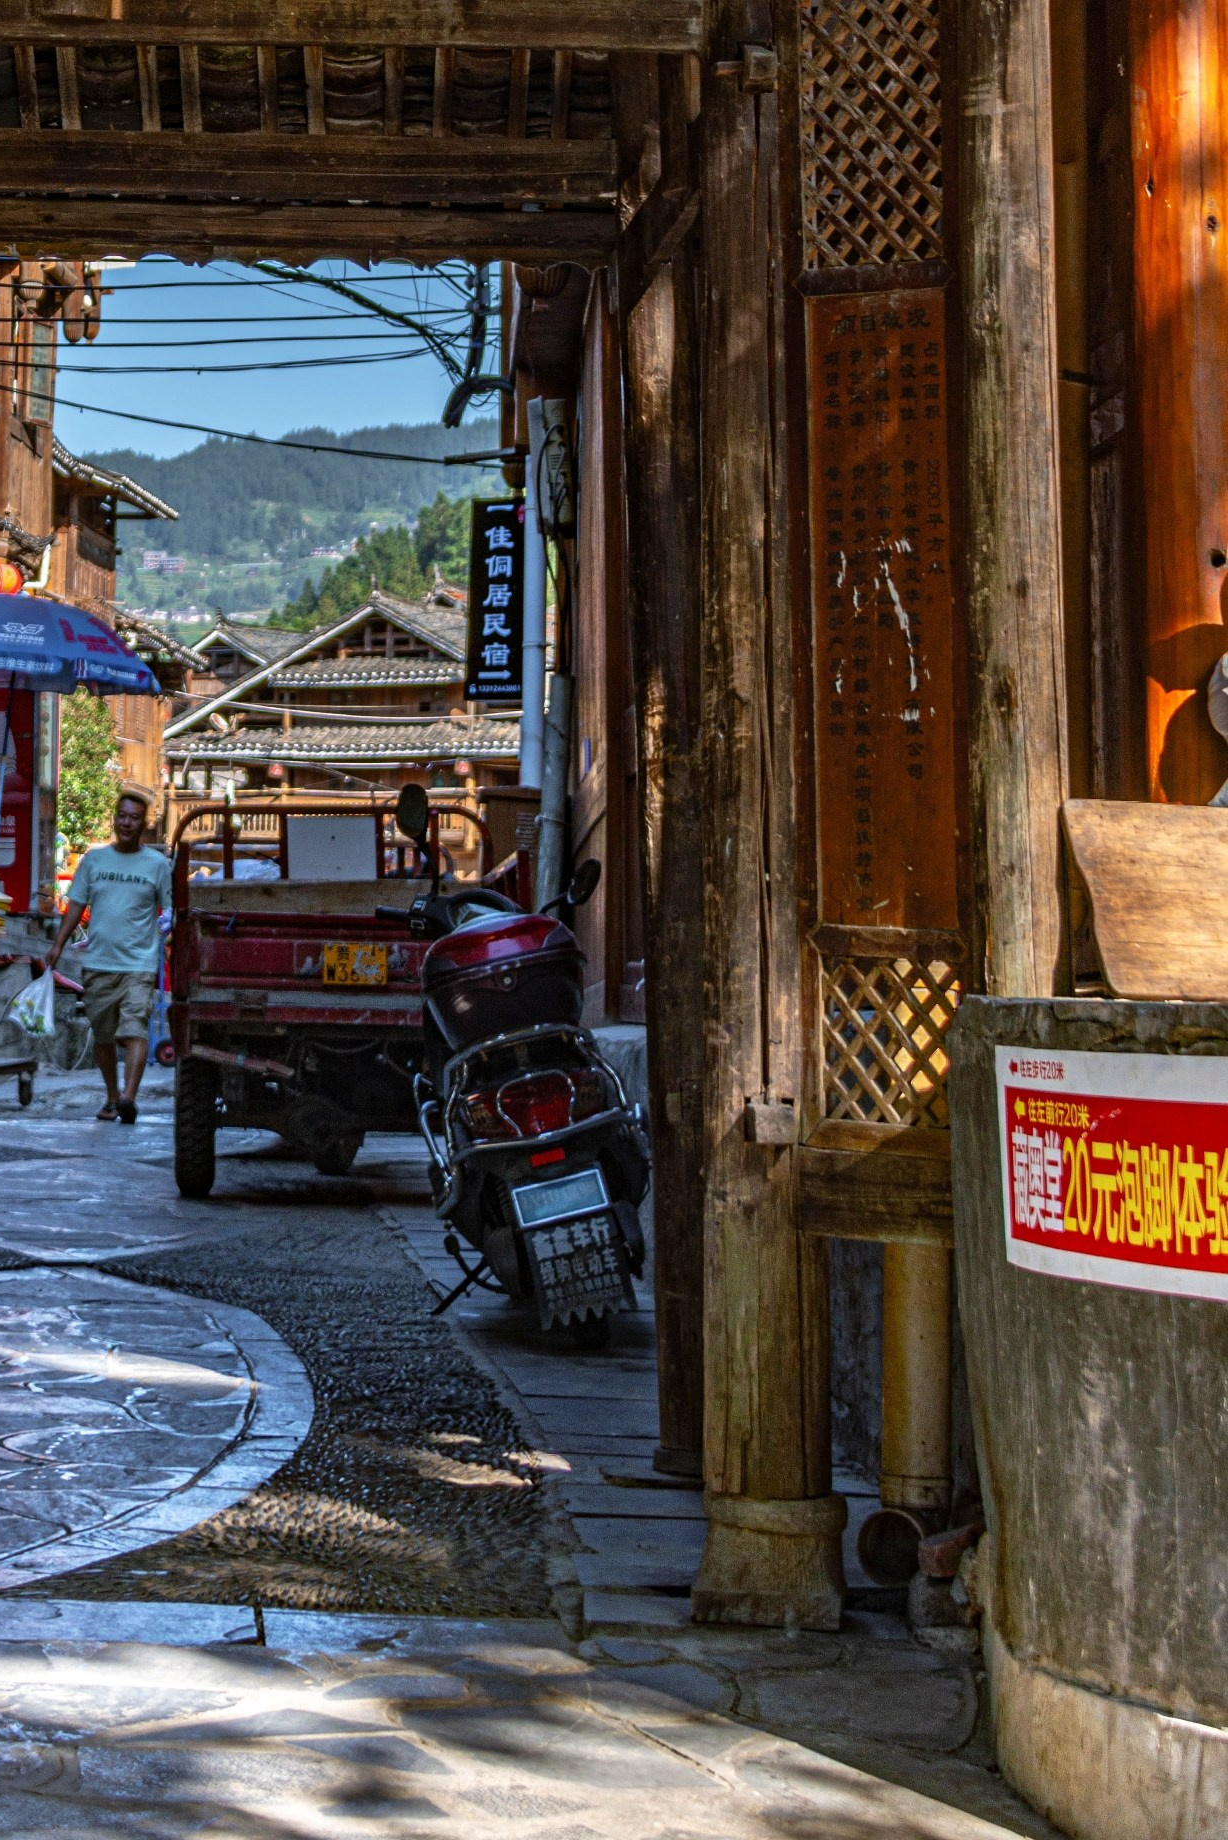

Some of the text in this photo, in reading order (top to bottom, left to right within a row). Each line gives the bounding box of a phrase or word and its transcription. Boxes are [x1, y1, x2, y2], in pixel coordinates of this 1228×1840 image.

[95, 871, 149, 885] JUBILANT
[1019, 1059, 1065, 1080] 往左步行20米
[1028, 1097, 1091, 1129] 往左前行20米
